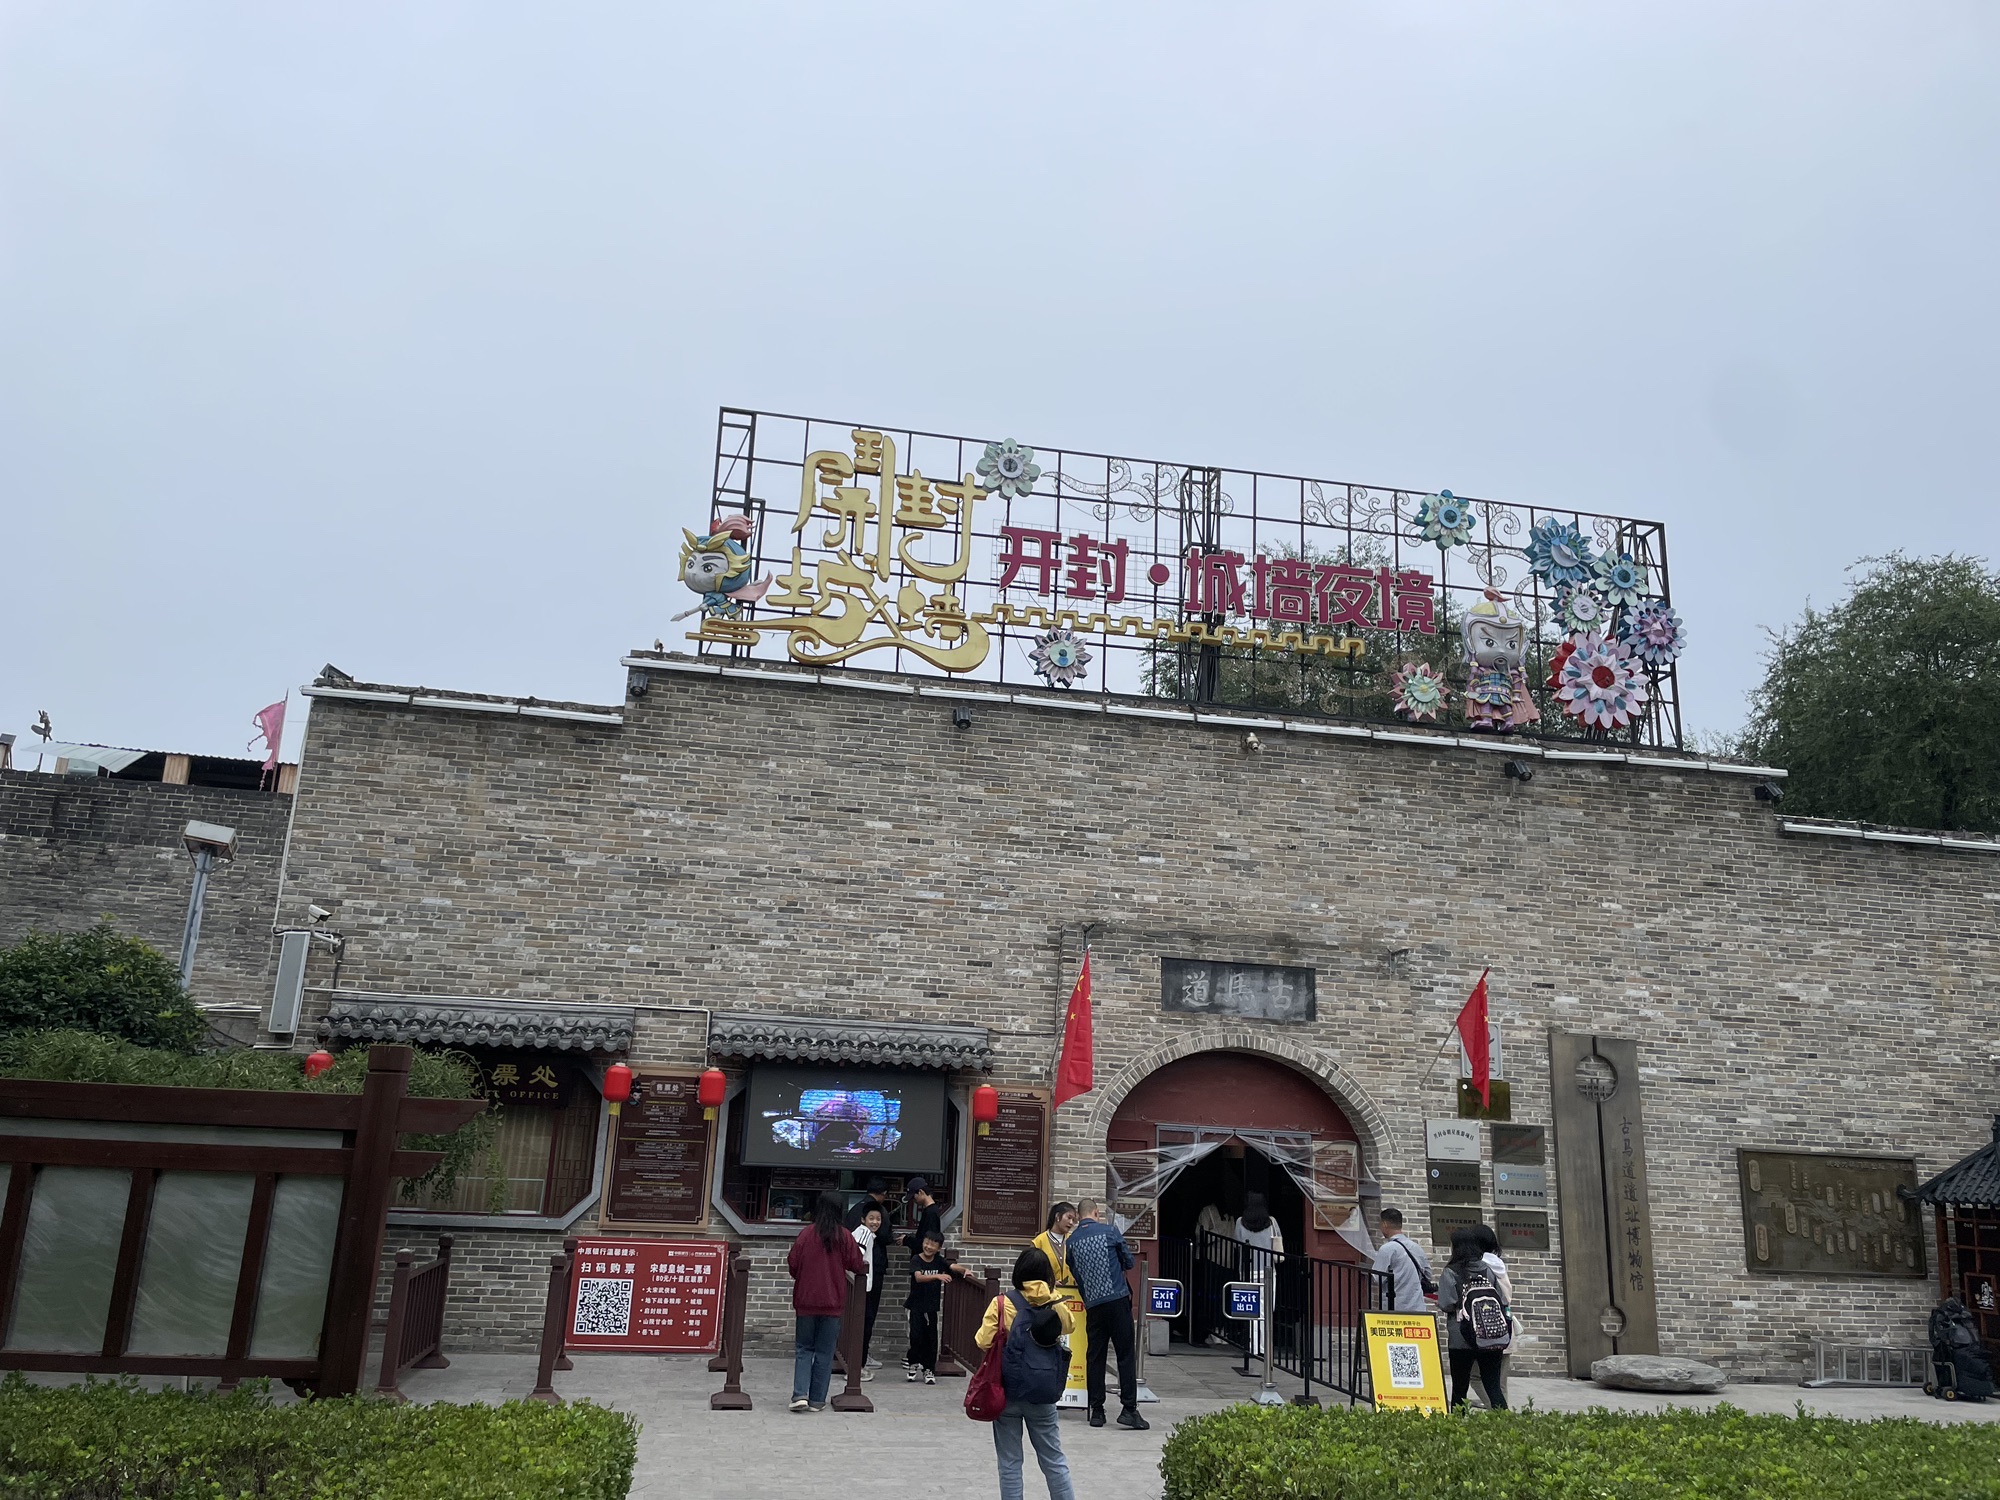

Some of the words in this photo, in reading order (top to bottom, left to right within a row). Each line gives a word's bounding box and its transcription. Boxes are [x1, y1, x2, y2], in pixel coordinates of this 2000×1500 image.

[510, 1091, 559, 1099] OFFICE
[1498, 1189, 1544, 1197] 校外实践教学基地
[1619, 1116, 1644, 1292] 古马道遗址博物馆
[581, 1262, 636, 1274] 扫码购票
[650, 1263, 711, 1275] 宋都皇城一票通
[1152, 1290, 1174, 1300] Exit
[1233, 1293, 1257, 1303] Exit
[1155, 1301, 1171, 1309] 出口
[1236, 1303, 1253, 1311] 出口
[1370, 1326, 1403, 1337] 美团买票
[1405, 1329, 1430, 1338] 超便宜
